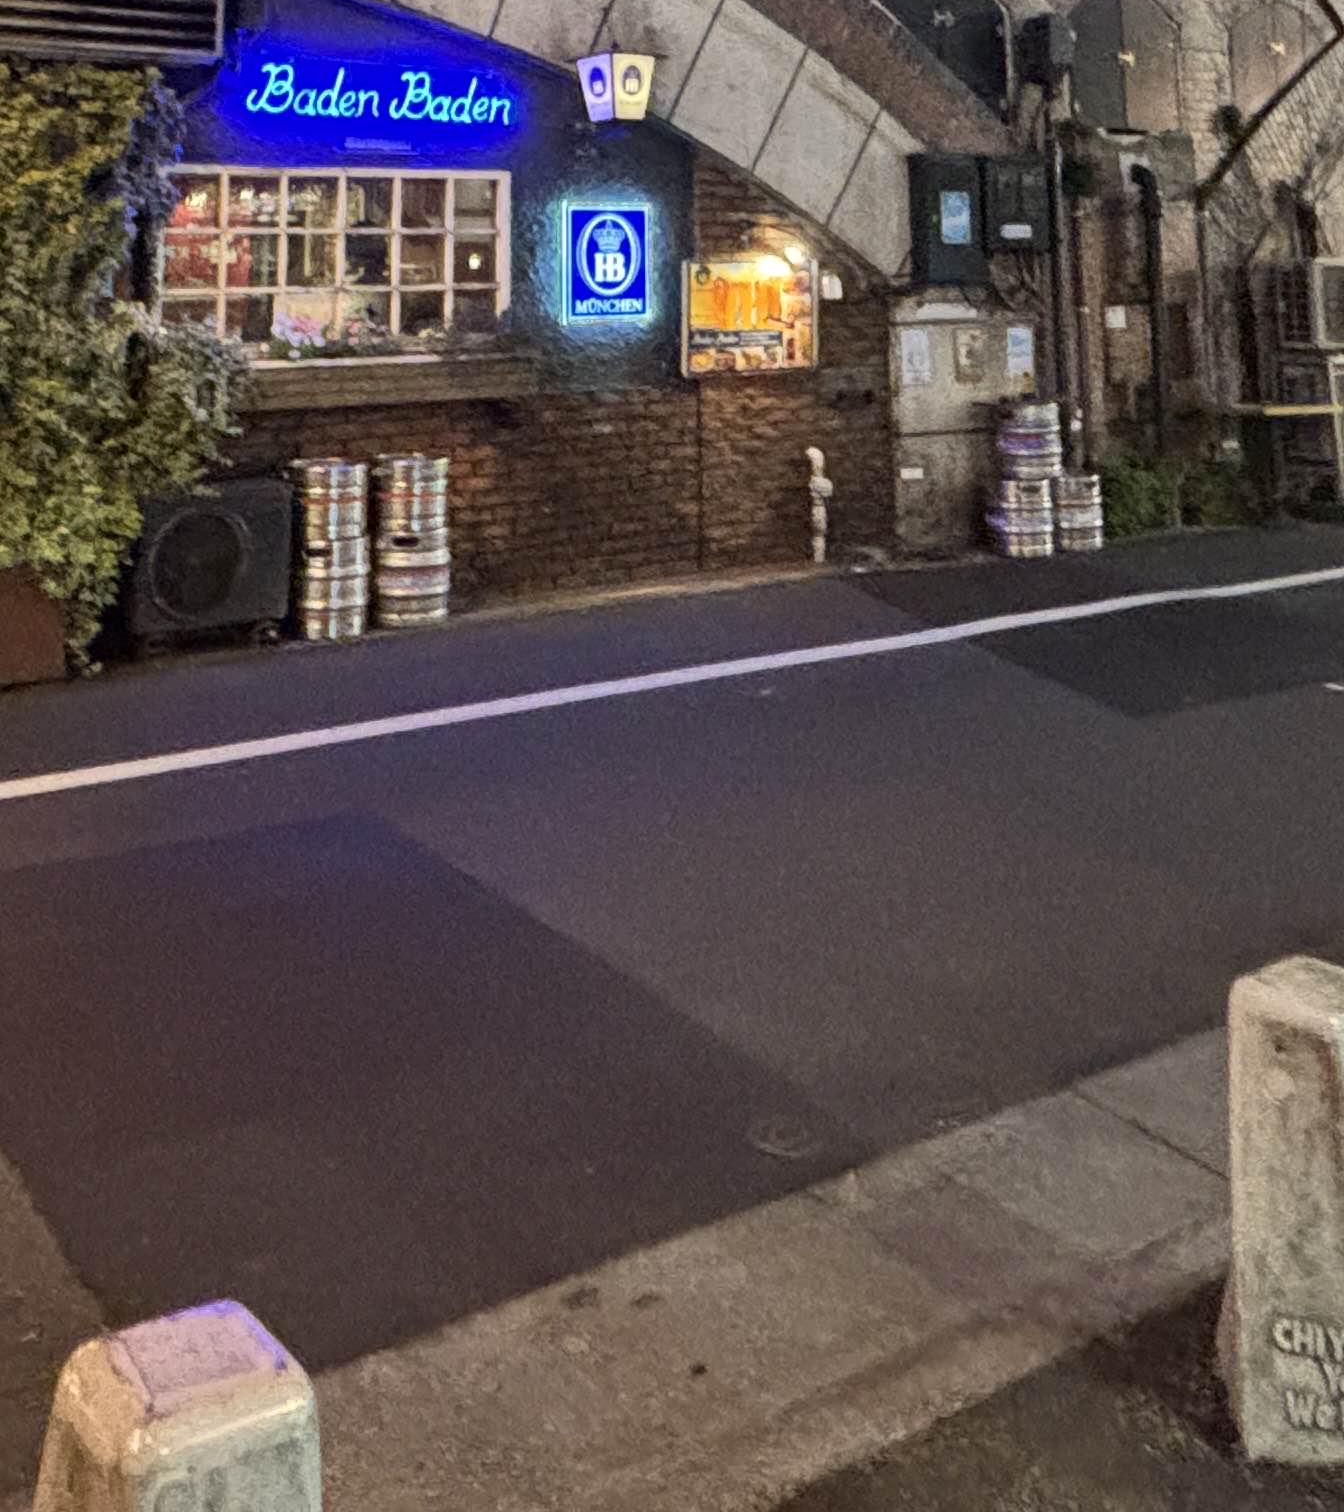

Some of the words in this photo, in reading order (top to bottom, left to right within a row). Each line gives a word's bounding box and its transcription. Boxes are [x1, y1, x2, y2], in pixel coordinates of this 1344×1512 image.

[246, 62, 379, 118] Baden
[388, 67, 511, 126] Baden
[594, 252, 626, 283] HB
[574, 297, 644, 314] MÜNCHEN
